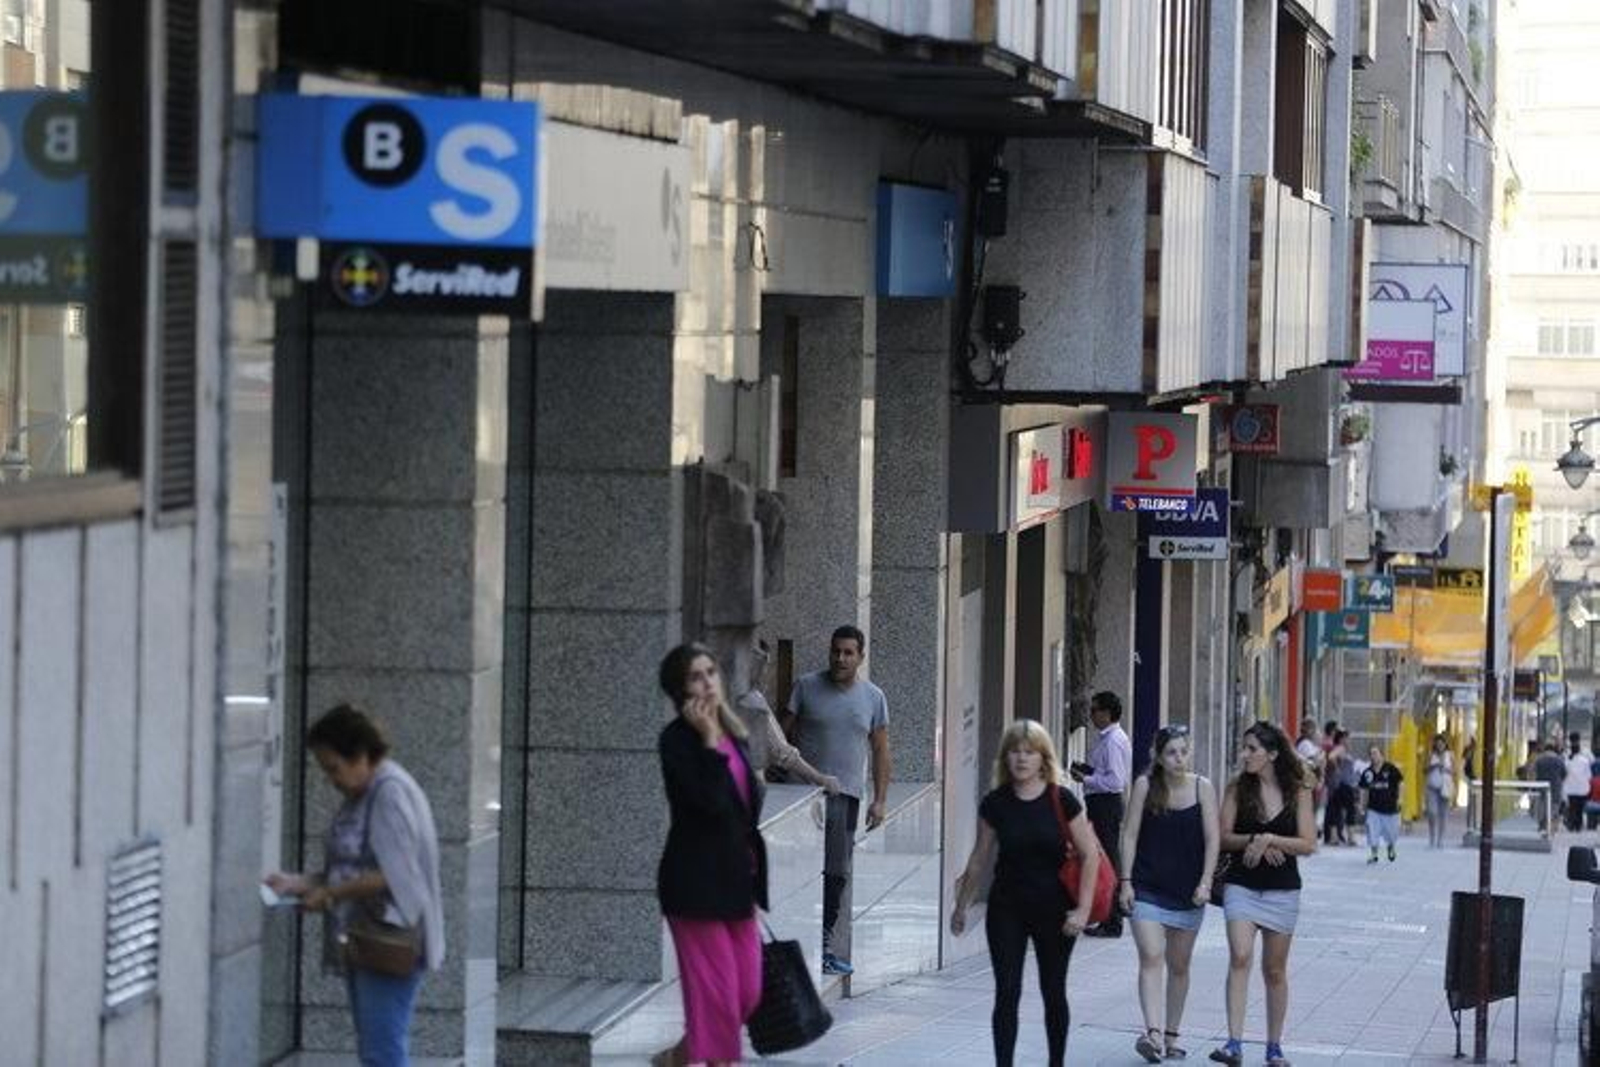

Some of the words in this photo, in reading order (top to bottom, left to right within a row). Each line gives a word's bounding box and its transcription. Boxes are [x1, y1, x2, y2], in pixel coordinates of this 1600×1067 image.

[393, 264, 522, 297] ServiRed
[1133, 425, 1177, 481] P
[1138, 498, 1189, 510] TELEBANCO
